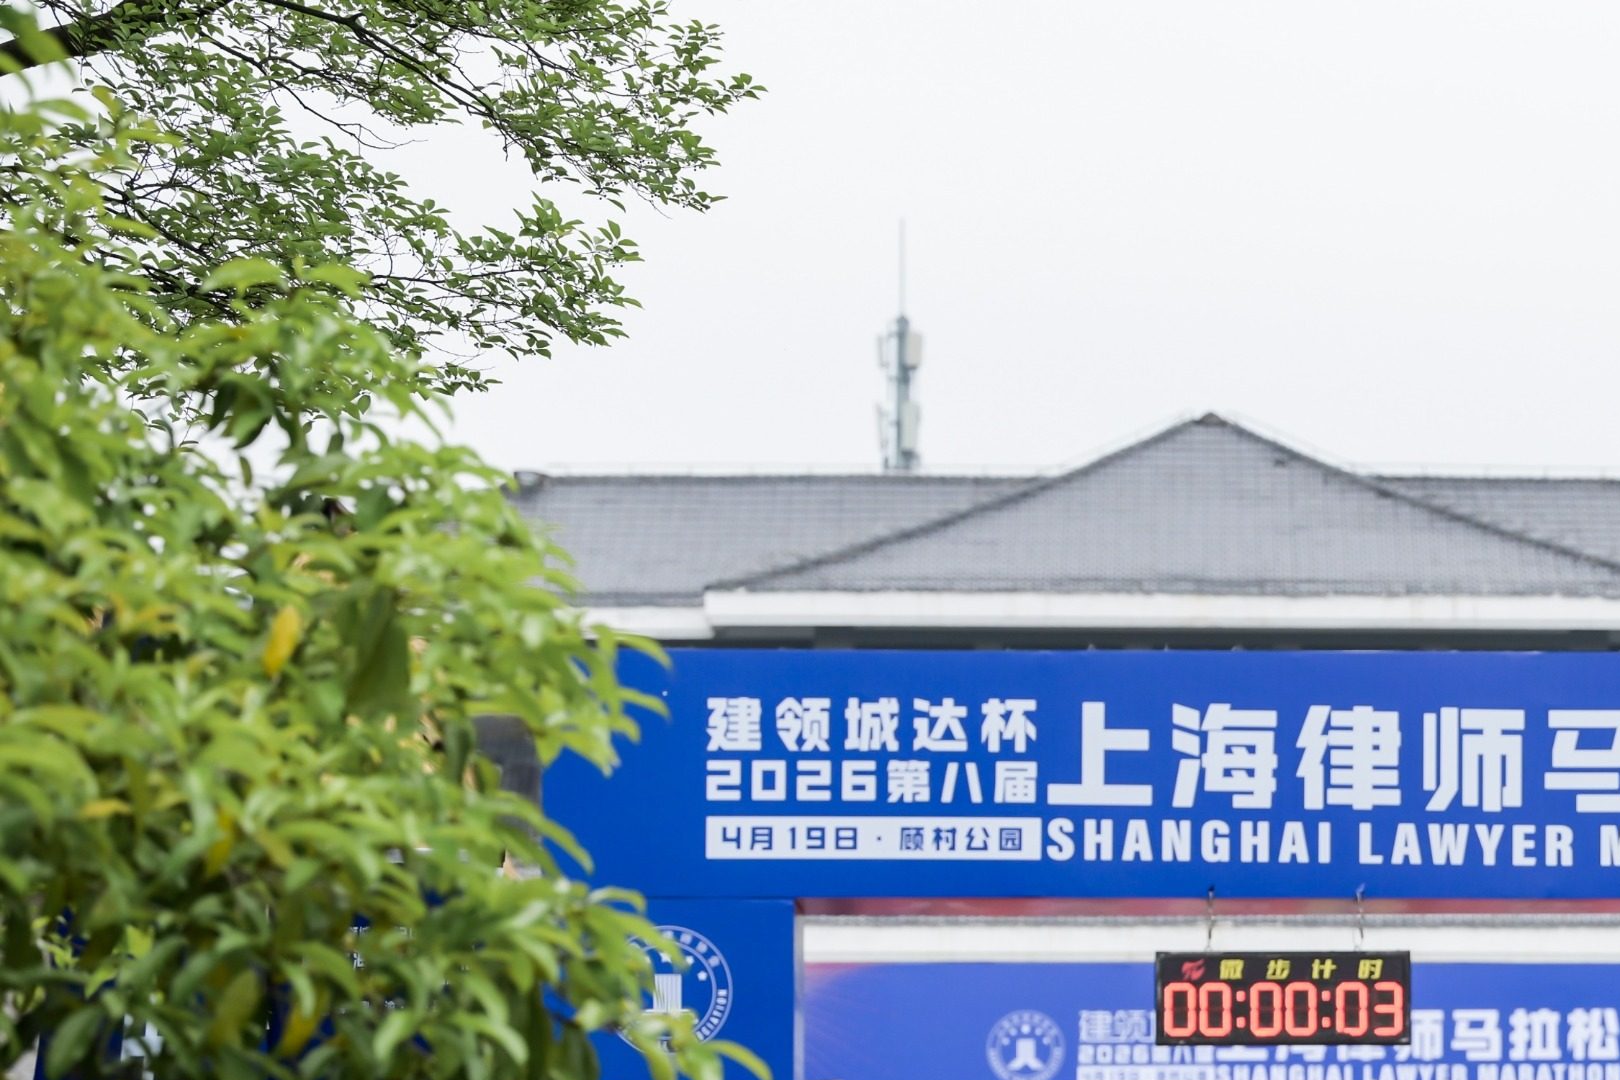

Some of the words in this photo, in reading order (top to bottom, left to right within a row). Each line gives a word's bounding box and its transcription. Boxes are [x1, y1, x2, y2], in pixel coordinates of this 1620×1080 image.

[706, 697, 1037, 753] 建领城达杯
[706, 759, 1038, 804] 2026第八届
[1047, 818, 1332, 864] SHANGHAI
[1358, 821, 1574, 867] LAWYER
[1219, 958, 1383, 980] 微步计时
[1163, 982, 1404, 1037] 00:00:03
